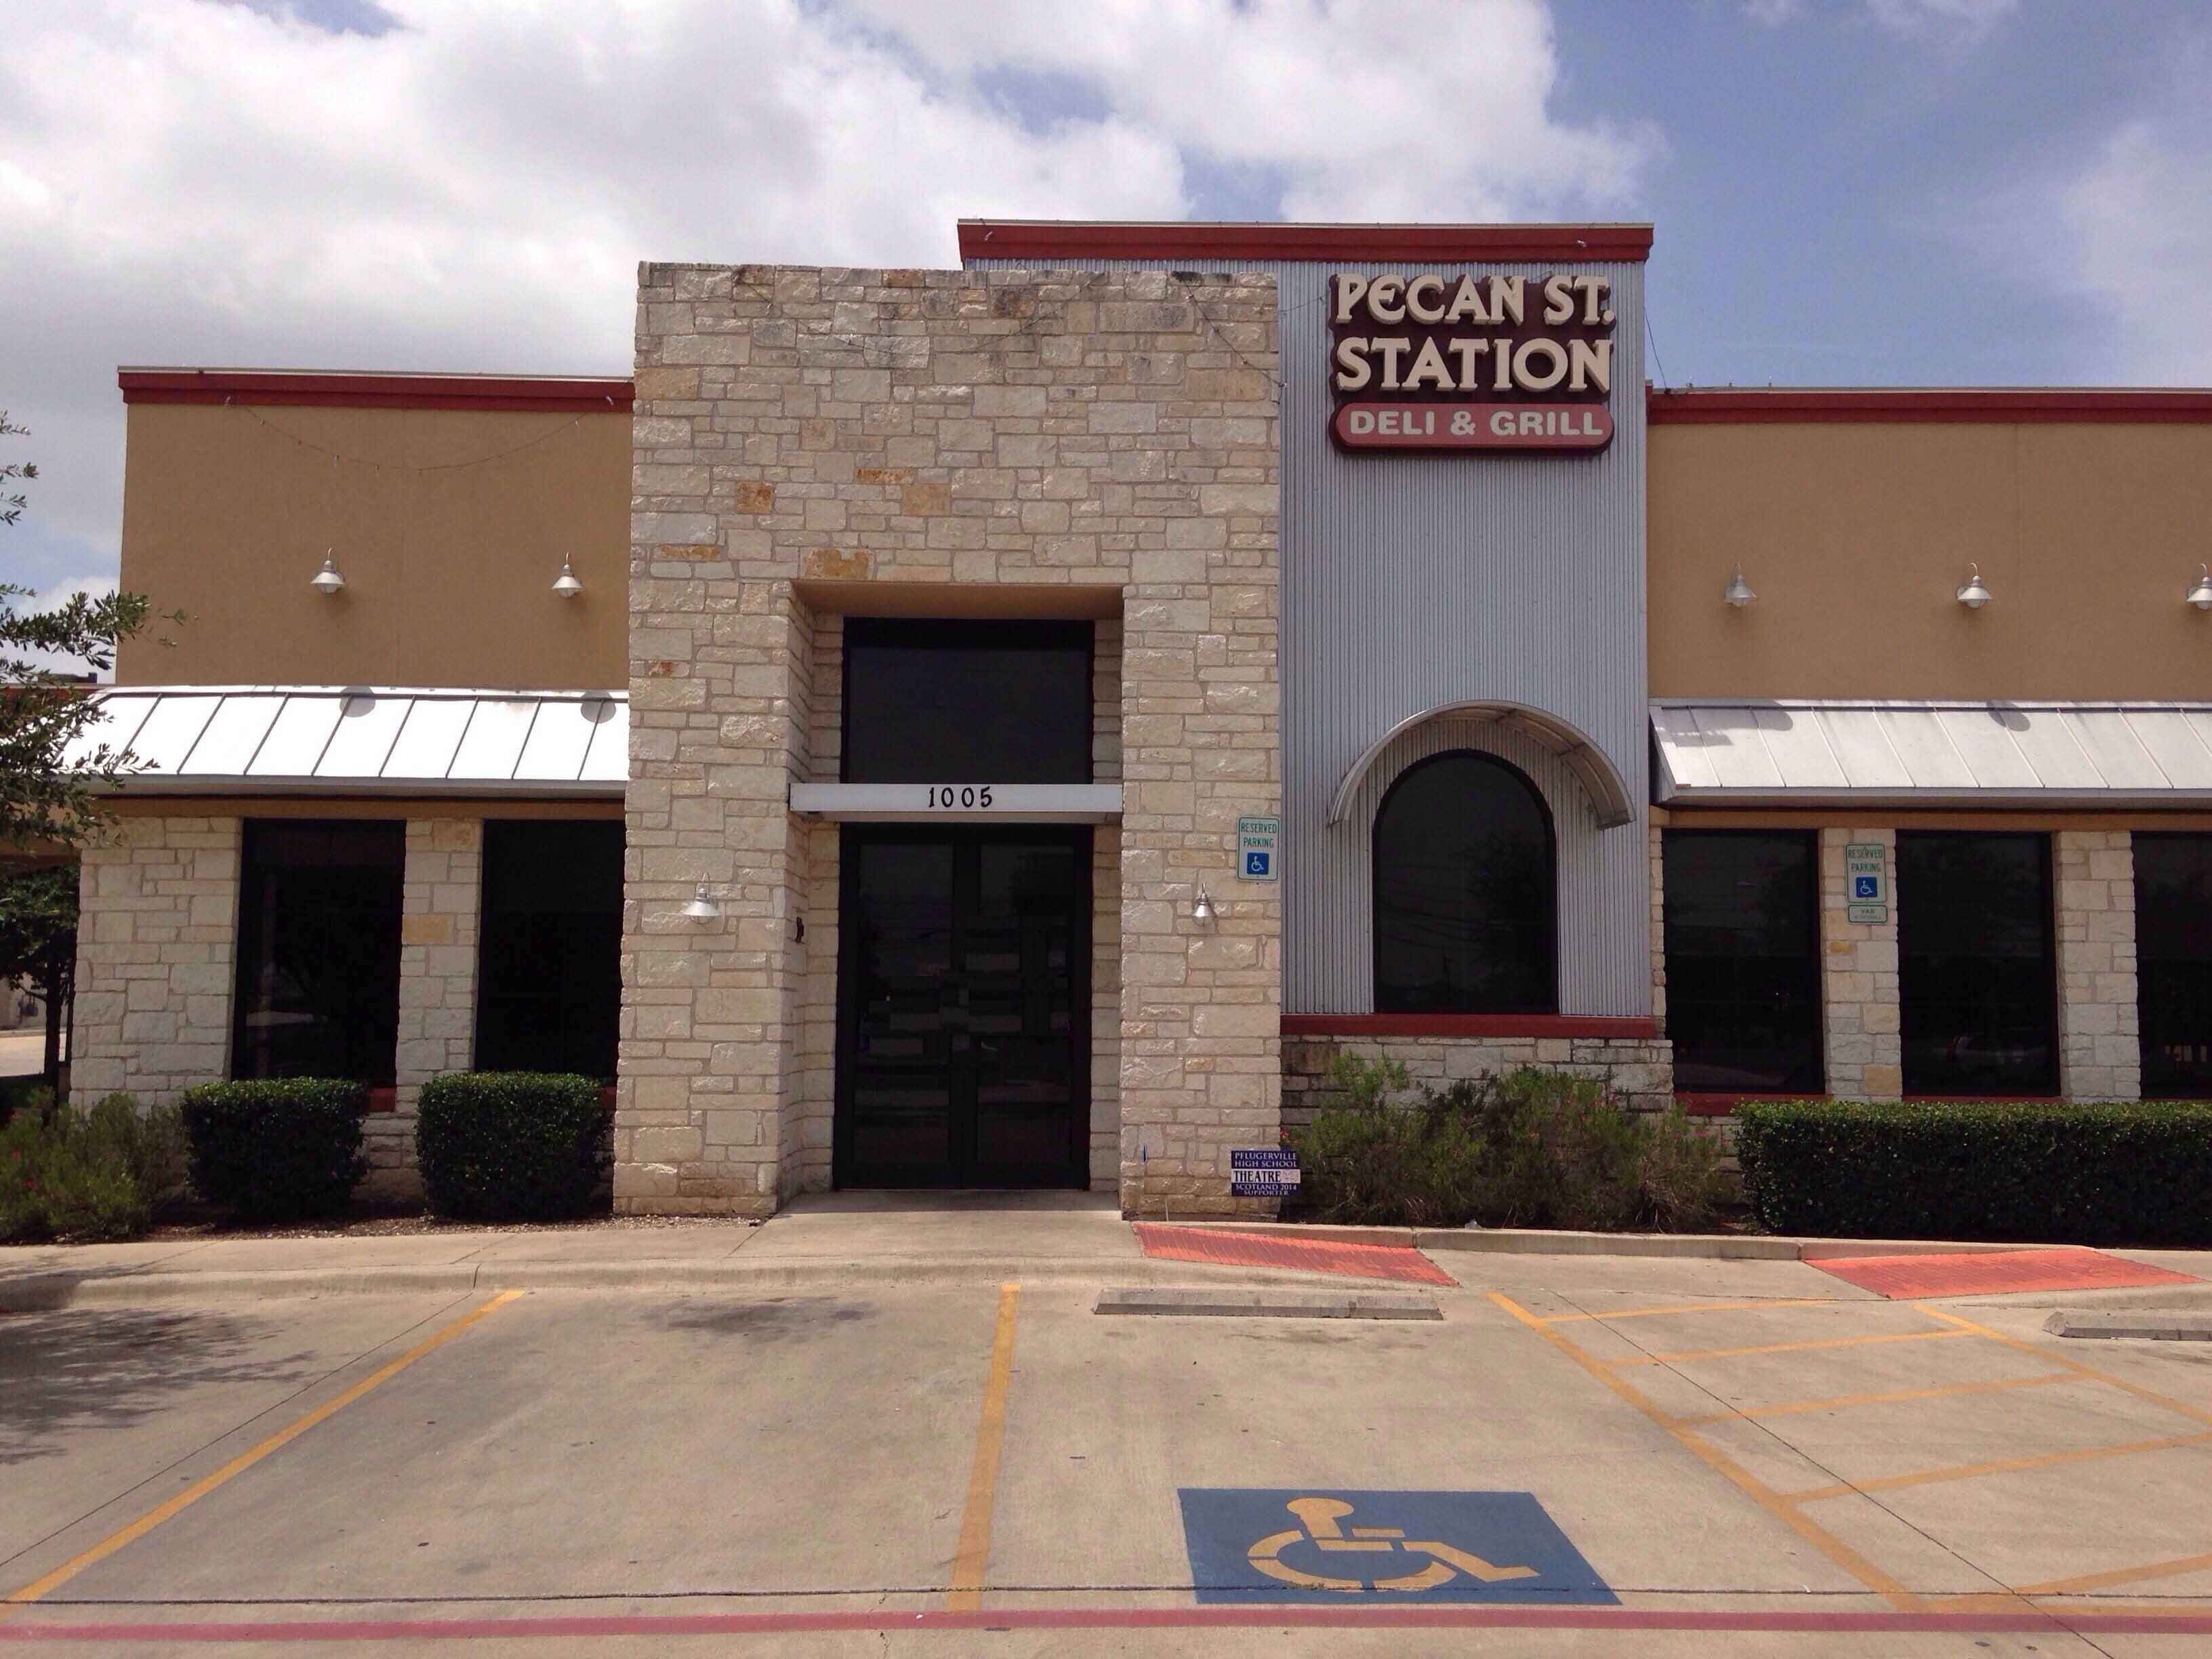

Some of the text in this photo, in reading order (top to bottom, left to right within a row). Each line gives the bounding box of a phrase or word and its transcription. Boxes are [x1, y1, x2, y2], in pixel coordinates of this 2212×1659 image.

[1335, 273, 1616, 326] PECAN ST.
[1336, 336, 1614, 393] STATION
[1351, 411, 1603, 435] DELI & GRILL
[928, 785, 992, 808] 1005
[1241, 823, 1277, 834] RESERVED
[1244, 837, 1274, 848] PARKING
[1847, 848, 1883, 859] RESERVED
[1851, 863, 1881, 872] PARKING
[1235, 1152, 1297, 1160] PFLUGERVILLE
[1233, 1170, 1281, 1183] THEATRE
